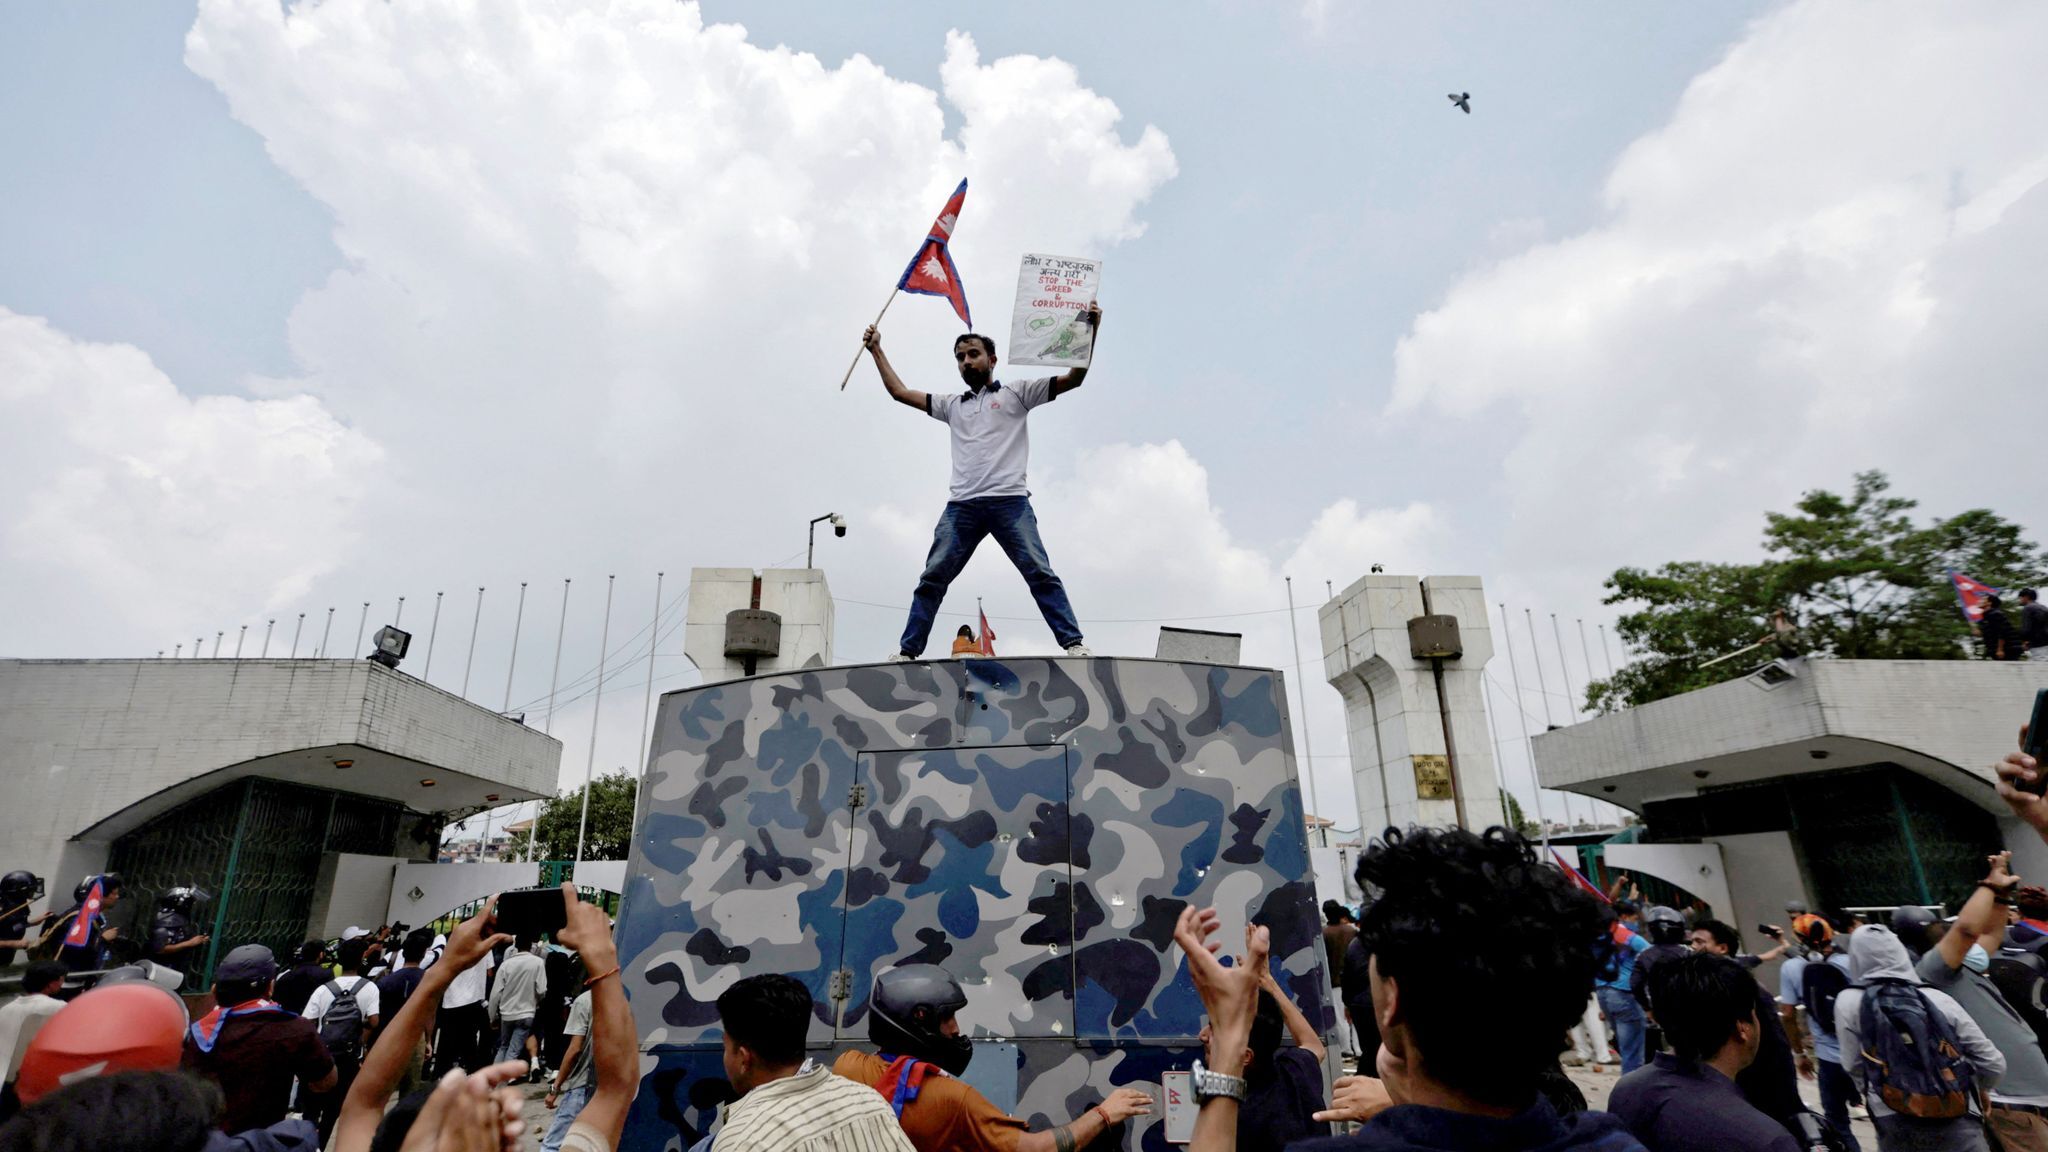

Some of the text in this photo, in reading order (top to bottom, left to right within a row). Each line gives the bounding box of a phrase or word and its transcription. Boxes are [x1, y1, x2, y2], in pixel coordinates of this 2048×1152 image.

[1038, 276, 1058, 284] STOP
[1045, 285, 1072, 293] GREED
[1032, 300, 1087, 310] CORRUPTION
